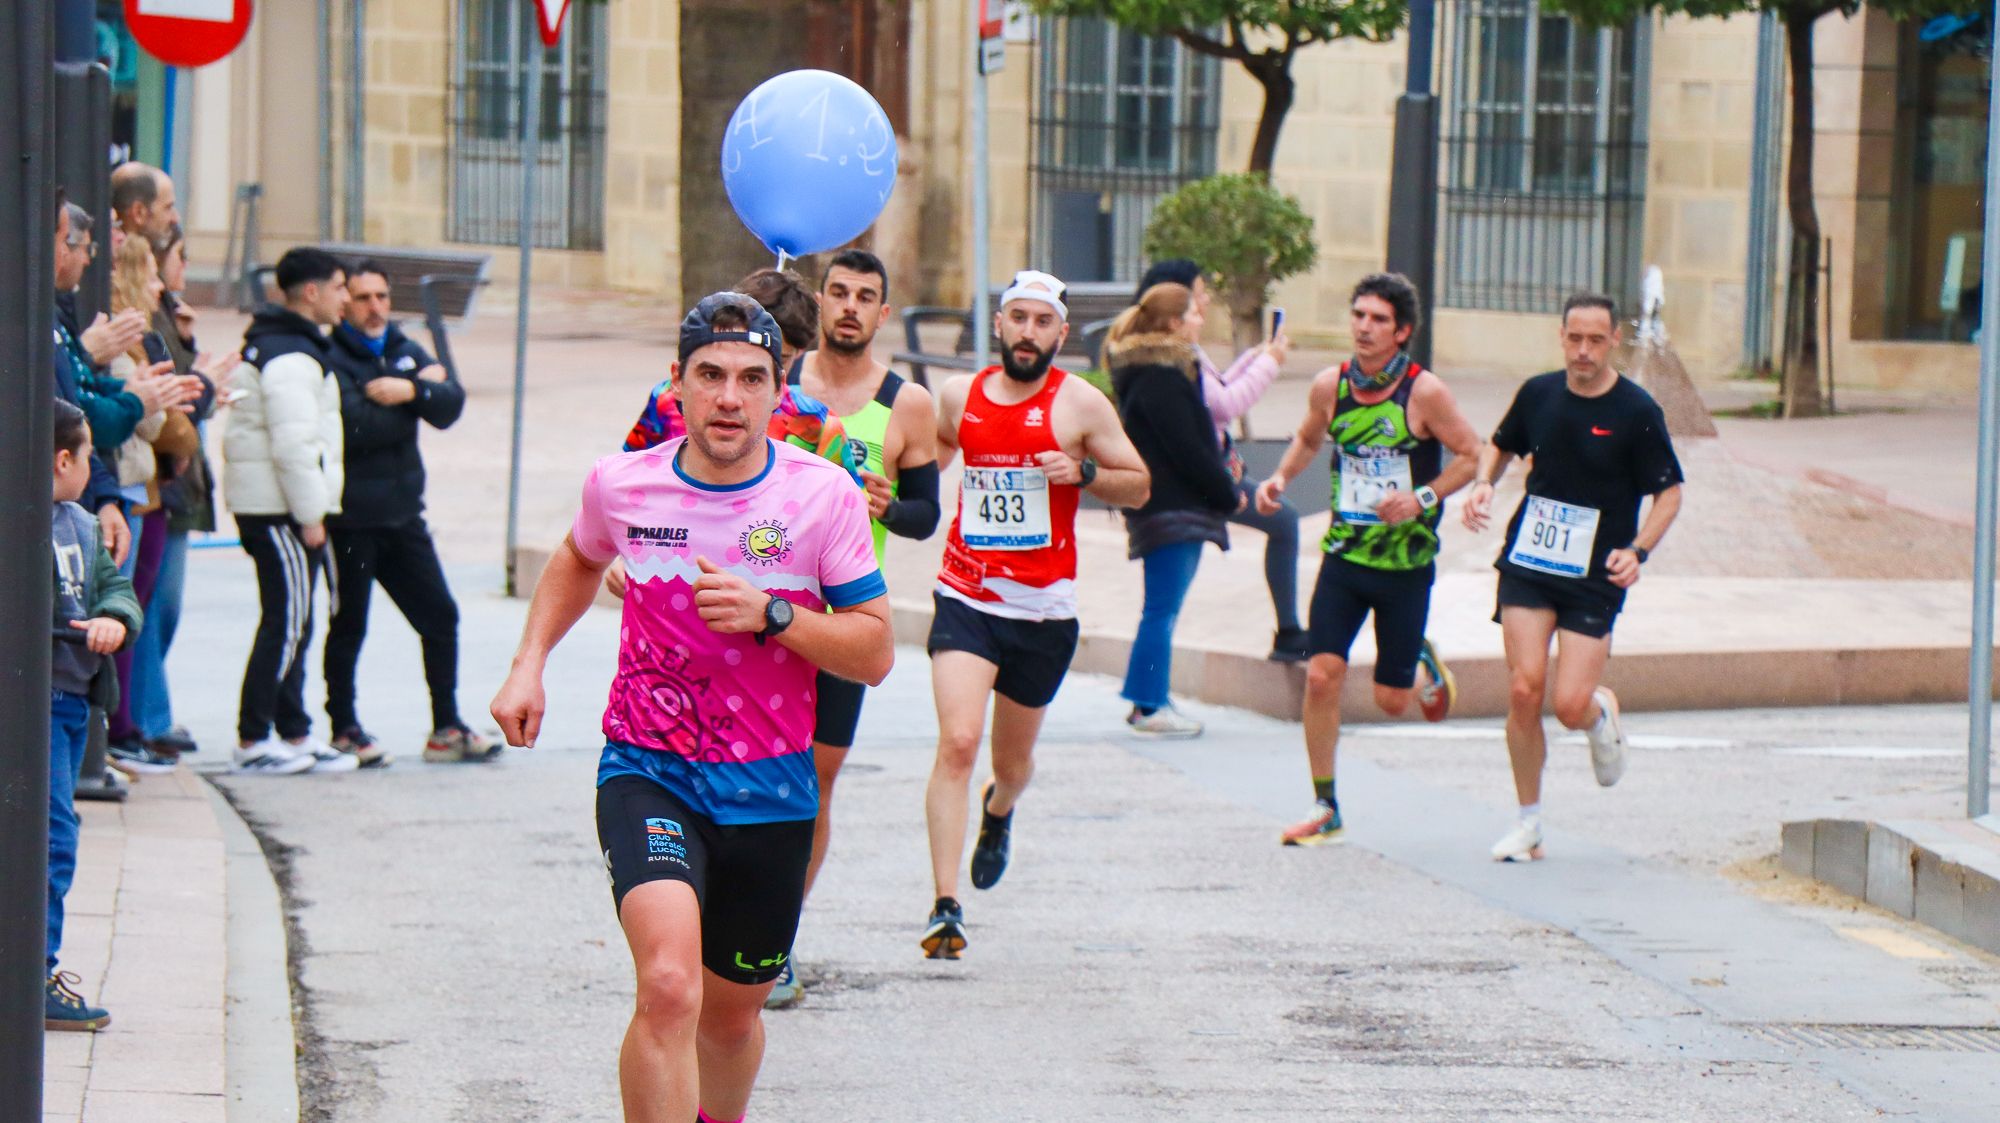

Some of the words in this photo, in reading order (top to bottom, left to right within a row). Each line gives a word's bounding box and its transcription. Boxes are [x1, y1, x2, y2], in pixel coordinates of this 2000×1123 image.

[979, 494, 1026, 523] 433
[756, 519, 769, 527] LA
[627, 526, 689, 541] IMPARABLES
[1532, 521, 1571, 552] 901
[648, 833, 671, 842] Club
[650, 846, 685, 859] Lucena
